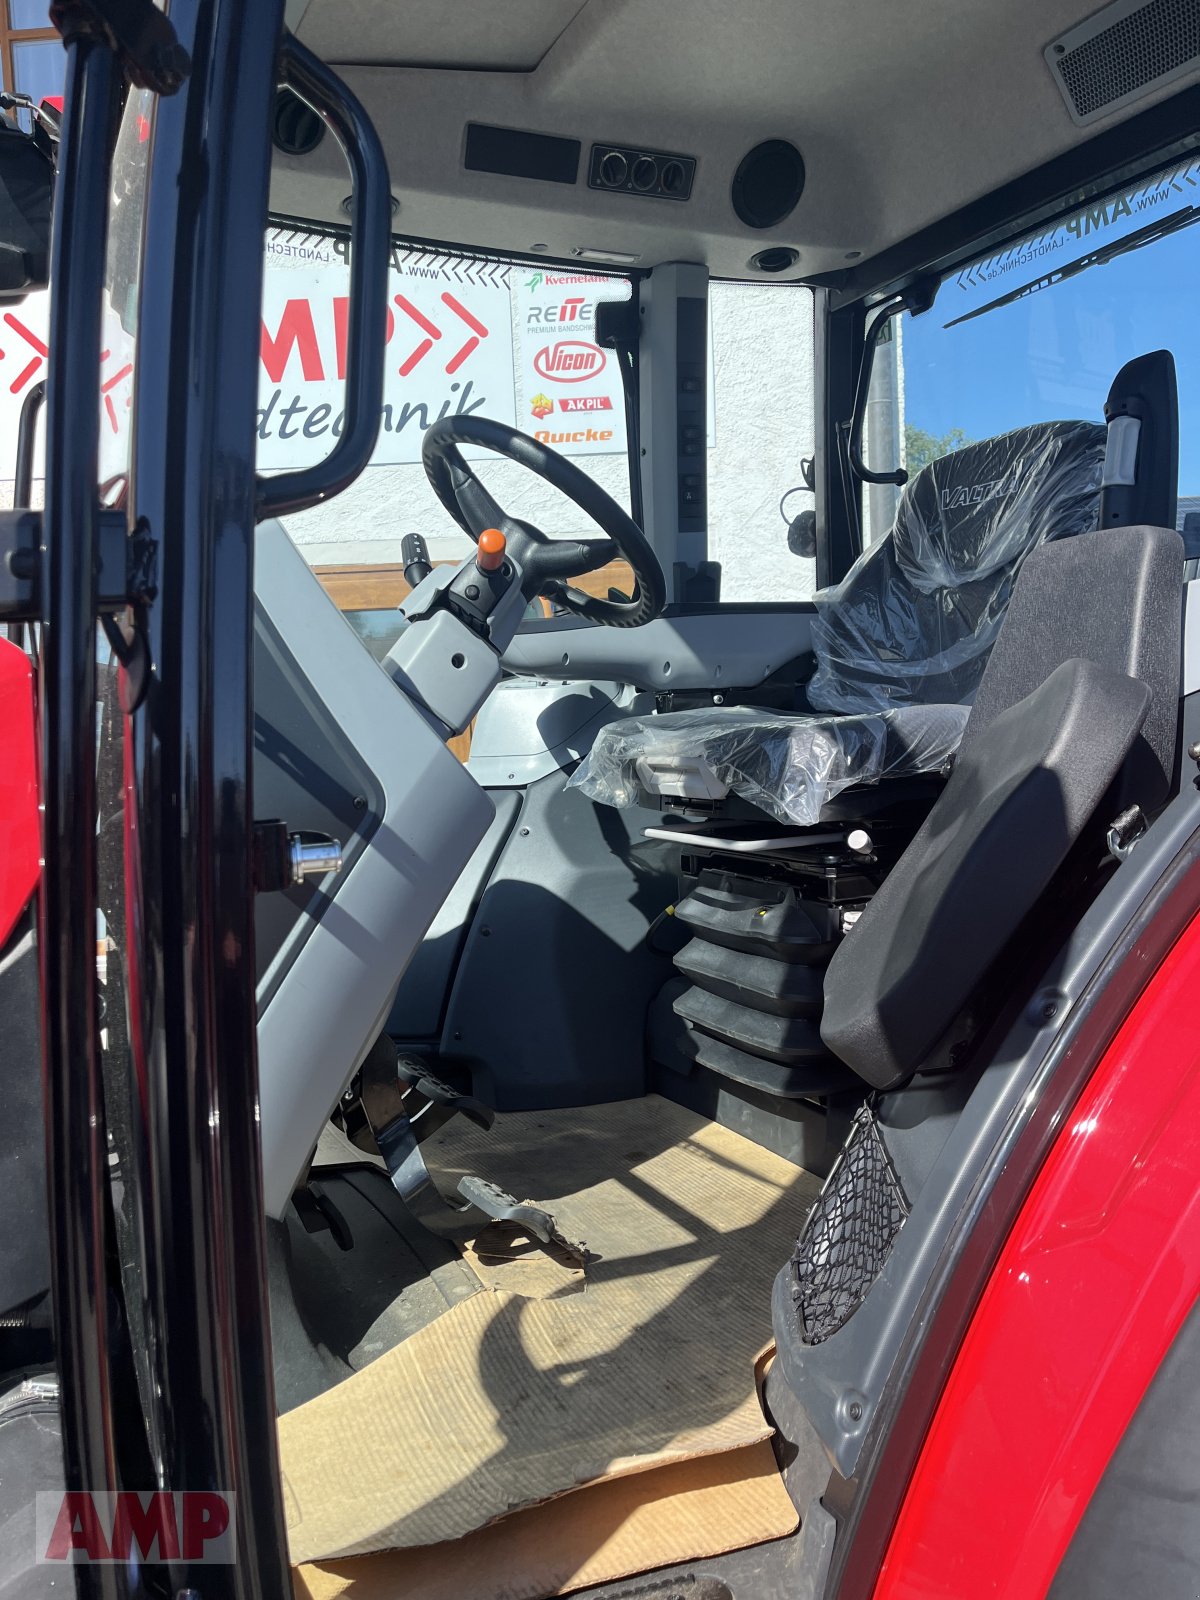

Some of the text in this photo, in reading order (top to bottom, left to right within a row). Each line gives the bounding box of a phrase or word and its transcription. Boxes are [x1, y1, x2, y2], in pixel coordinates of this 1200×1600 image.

[527, 297, 593, 324] REITE
[527, 323, 594, 334] PREMIUM BANDSCHW
[543, 343, 597, 372] Vicon
[534, 428, 613, 444] Quicke
